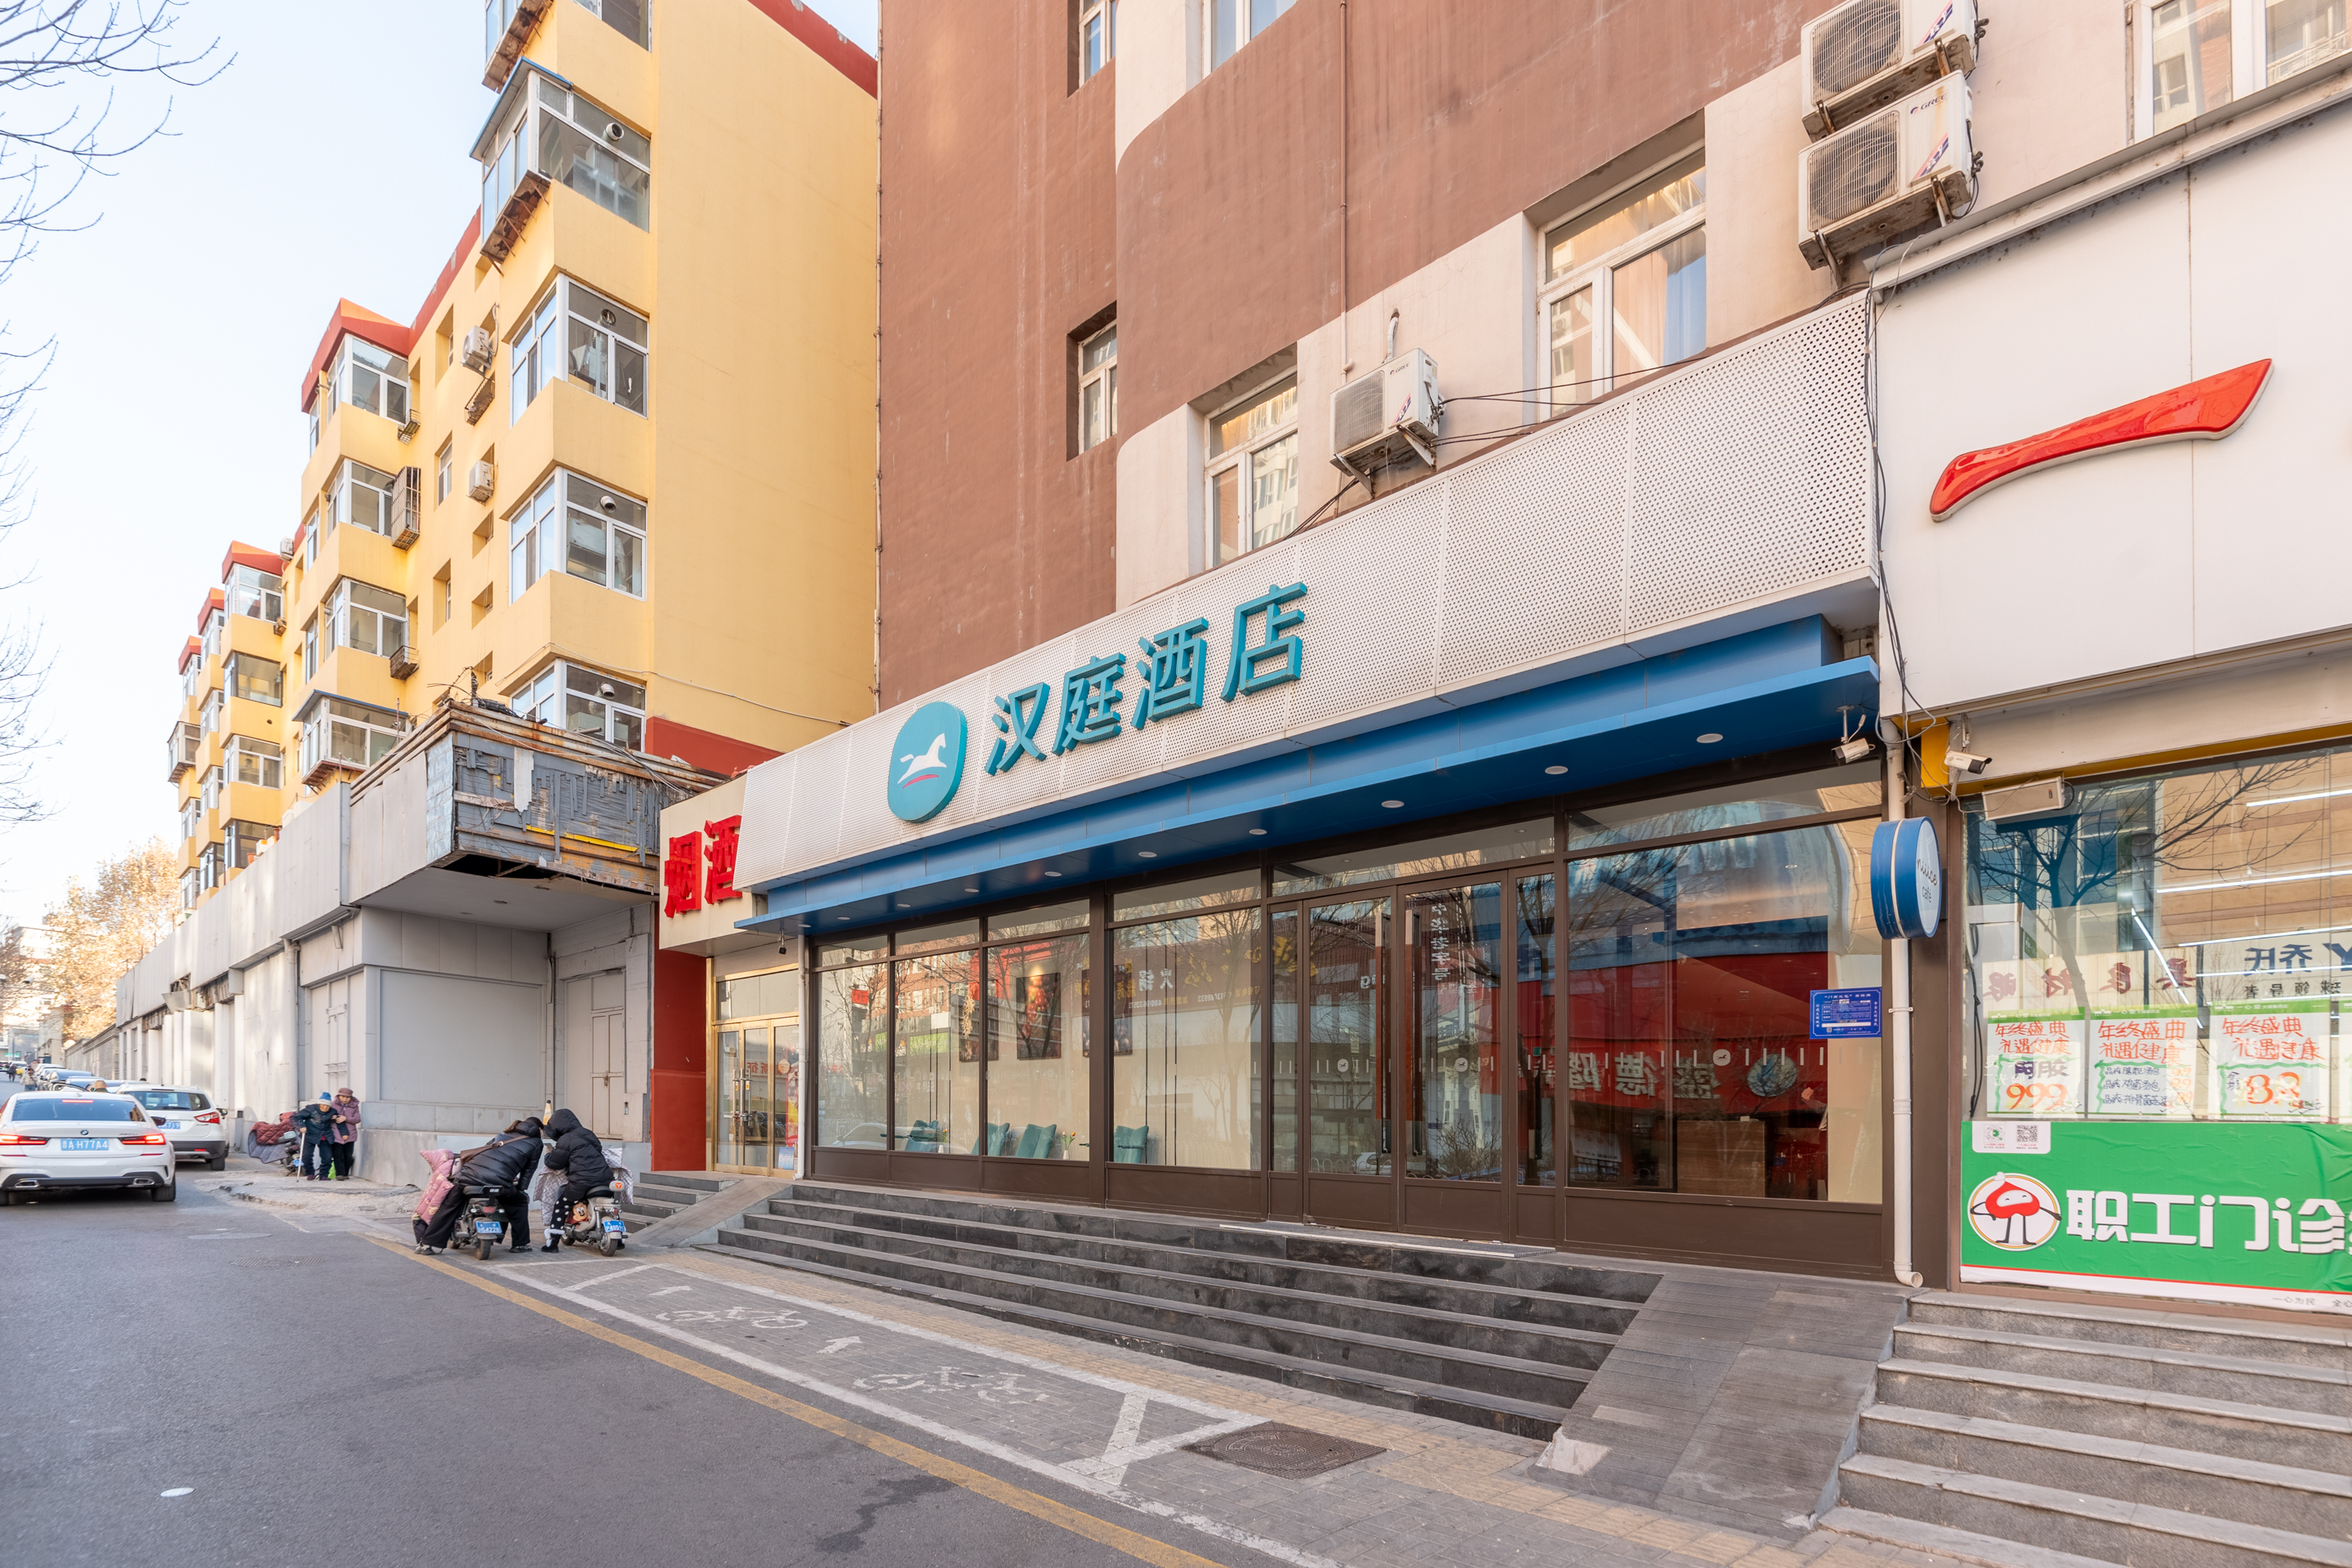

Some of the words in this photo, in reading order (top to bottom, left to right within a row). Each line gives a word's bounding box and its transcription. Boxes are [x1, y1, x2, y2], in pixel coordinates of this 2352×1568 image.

[1920, 92, 1948, 111] GREE
[984, 581, 1307, 776] 汉庭酒店
[664, 815, 743, 919] 烟酒
[1995, 1020, 2070, 1039] 年终盛典
[2097, 1019, 2186, 1043] 年终盛典
[2221, 1016, 2304, 1037] 年终盛典
[1998, 1036, 2071, 1055] 礼遇健康
[2099, 1040, 2192, 1067] 礼遇健康
[2006, 1082, 2069, 1111] 999
[2065, 1189, 2352, 1255] 职工门诊
[2272, 1296, 2316, 1306] 一心为民
